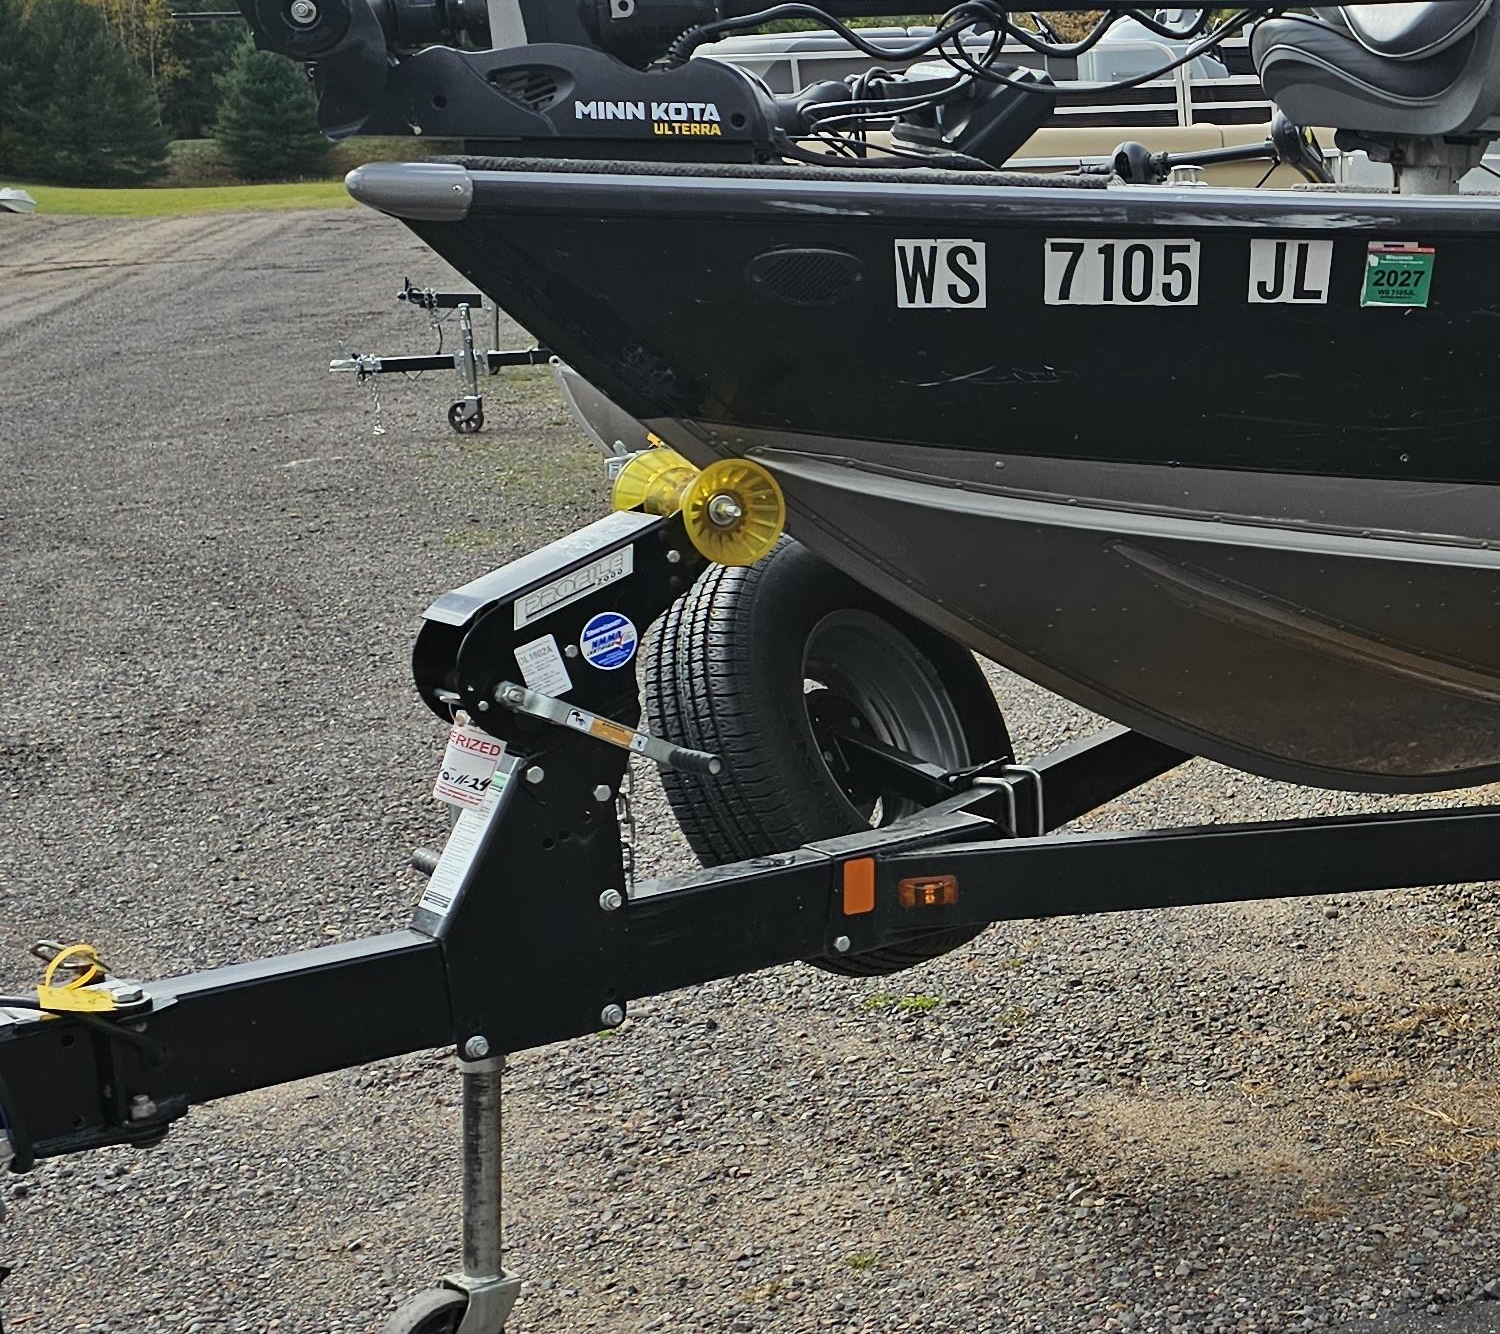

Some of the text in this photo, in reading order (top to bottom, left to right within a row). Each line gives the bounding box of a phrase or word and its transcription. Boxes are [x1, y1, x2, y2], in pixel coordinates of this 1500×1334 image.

[575, 101, 721, 121] MINN KOTA
[654, 123, 721, 135] ULTERRA
[897, 241, 1323, 305] WS 7105 JL
[1372, 269, 1425, 287] 2027
[525, 553, 624, 616] PROFILE
[596, 568, 623, 585] 2000
